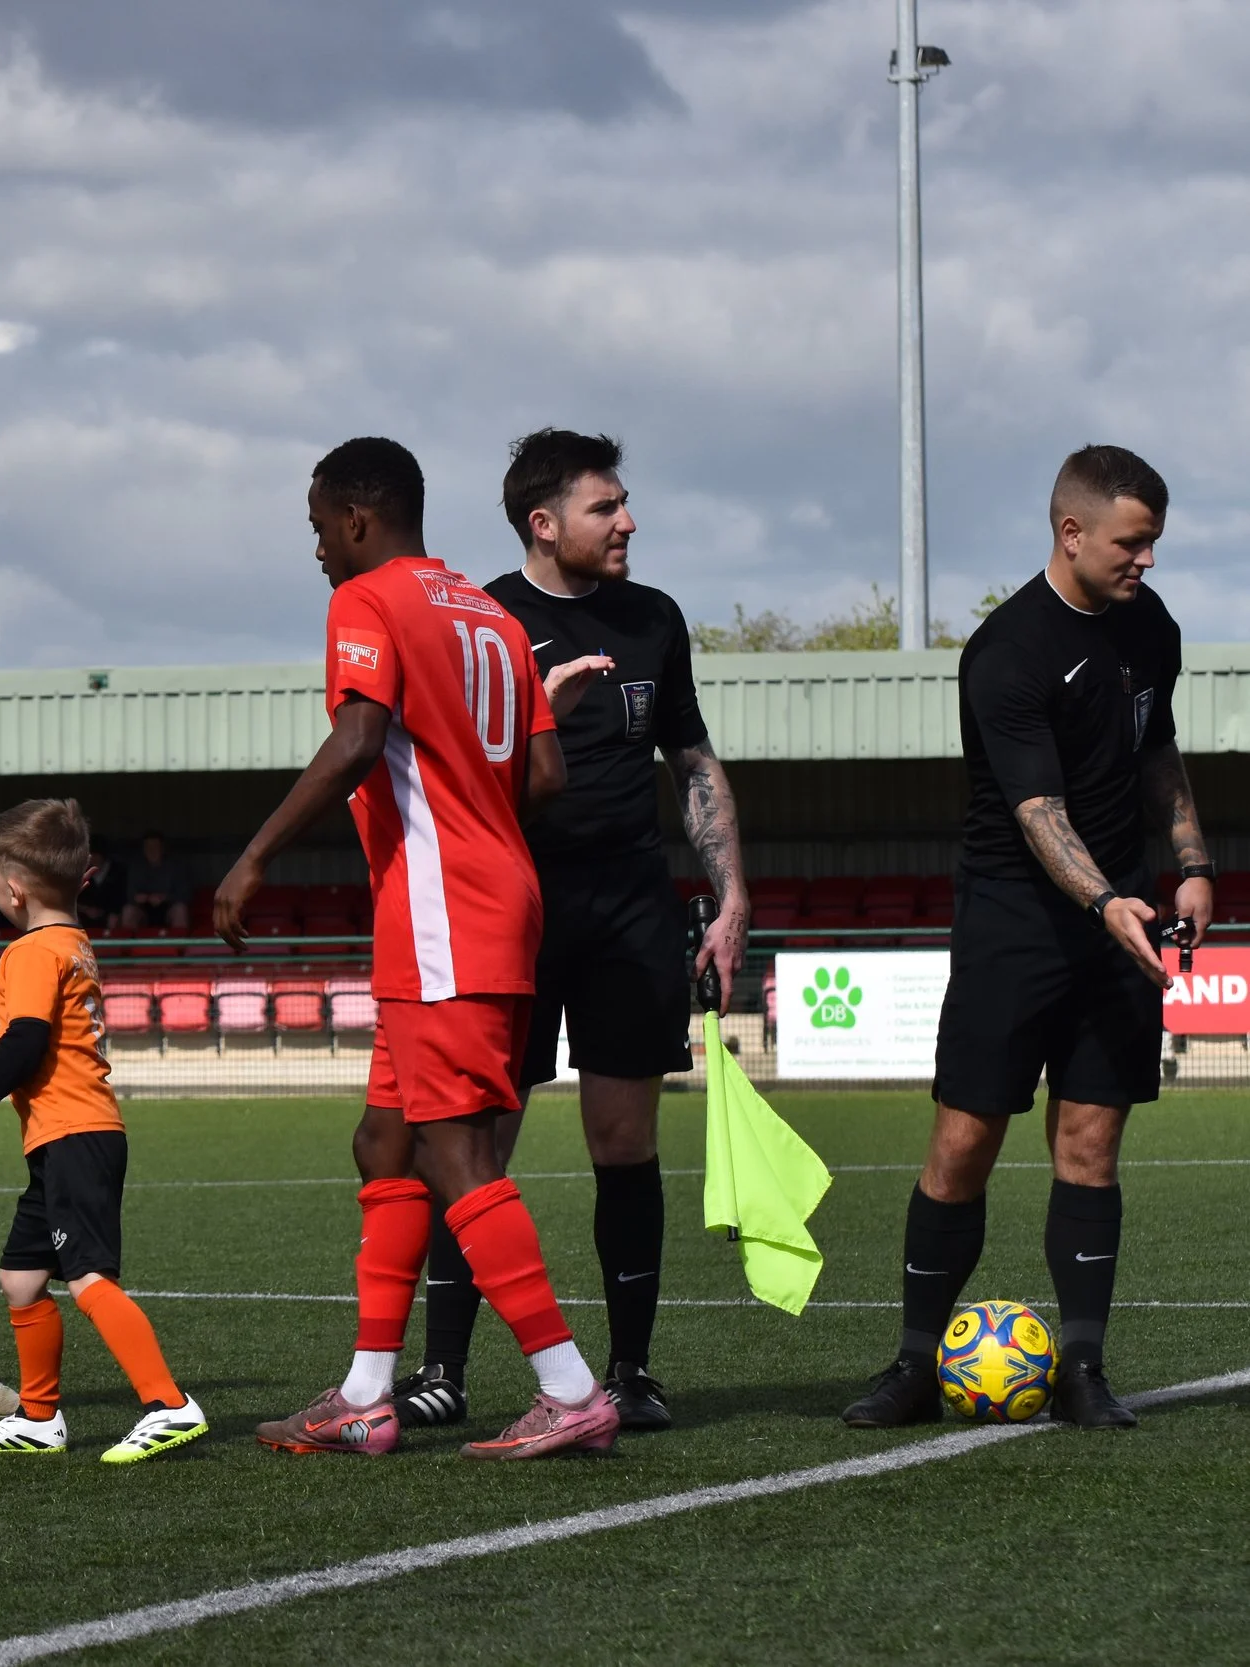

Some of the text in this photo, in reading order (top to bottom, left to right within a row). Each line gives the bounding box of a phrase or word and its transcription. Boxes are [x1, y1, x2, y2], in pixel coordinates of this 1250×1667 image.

[336, 643, 371, 657] PITCHING
[350, 652, 359, 662] IN
[452, 619, 515, 762] 10
[821, 1004, 847, 1022] DB
